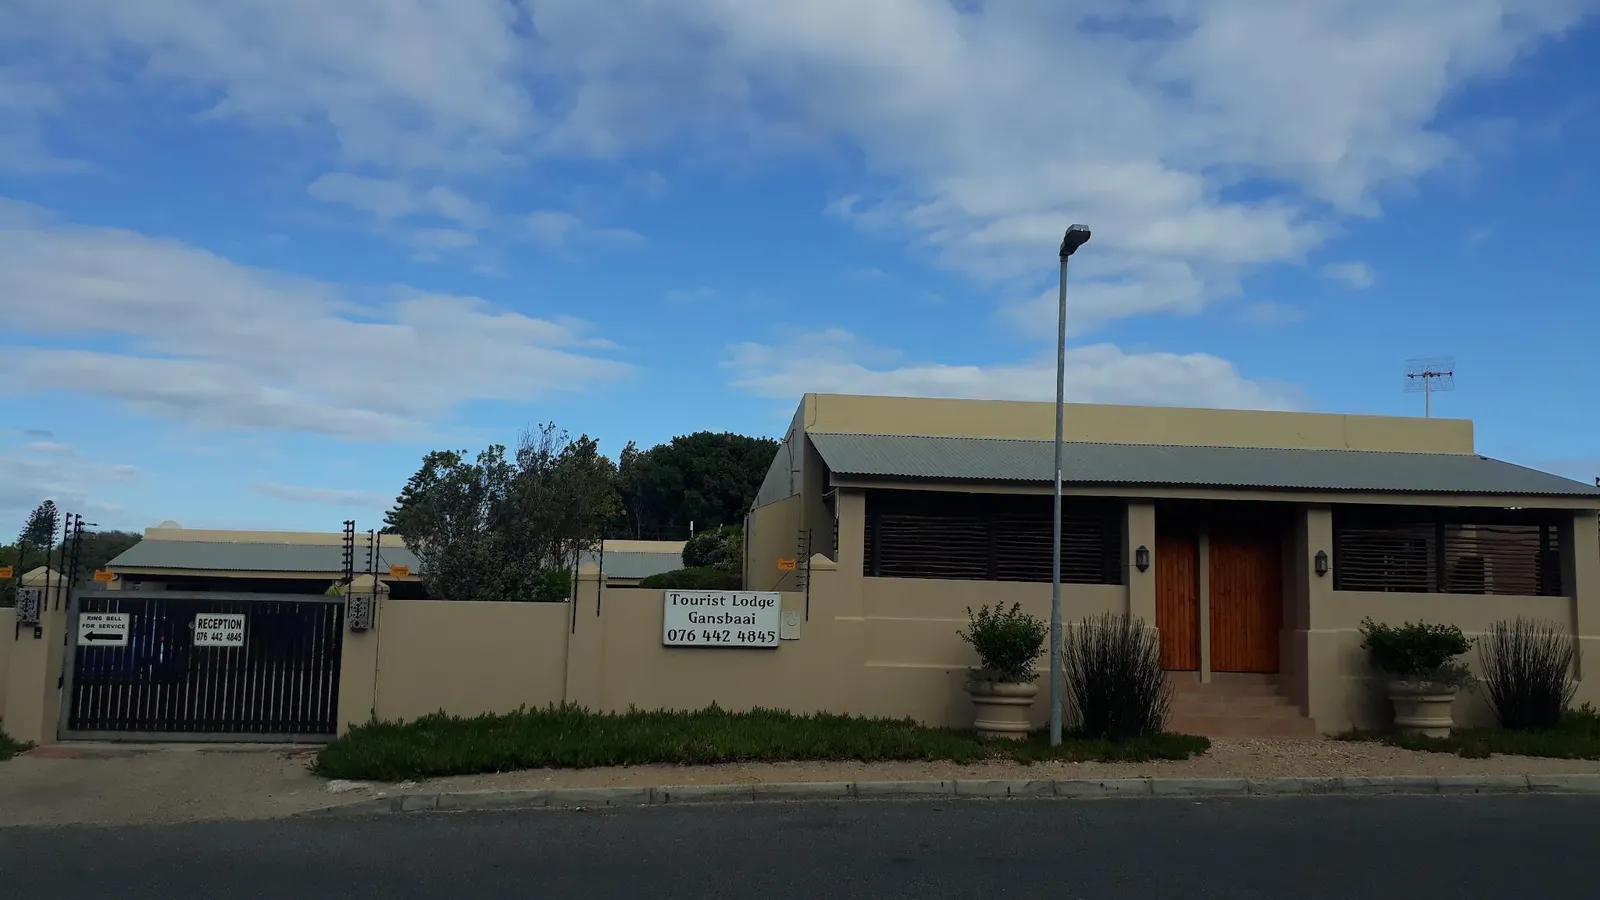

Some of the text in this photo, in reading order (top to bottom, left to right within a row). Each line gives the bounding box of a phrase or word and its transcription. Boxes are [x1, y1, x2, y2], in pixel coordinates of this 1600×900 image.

[670, 593, 775, 610] Tourist Lodge
[198, 618, 242, 630] RECEPTION
[688, 611, 756, 625] Gansbaai
[196, 631, 242, 642] 076 442 4845
[668, 629, 776, 643] 076 442 4845
